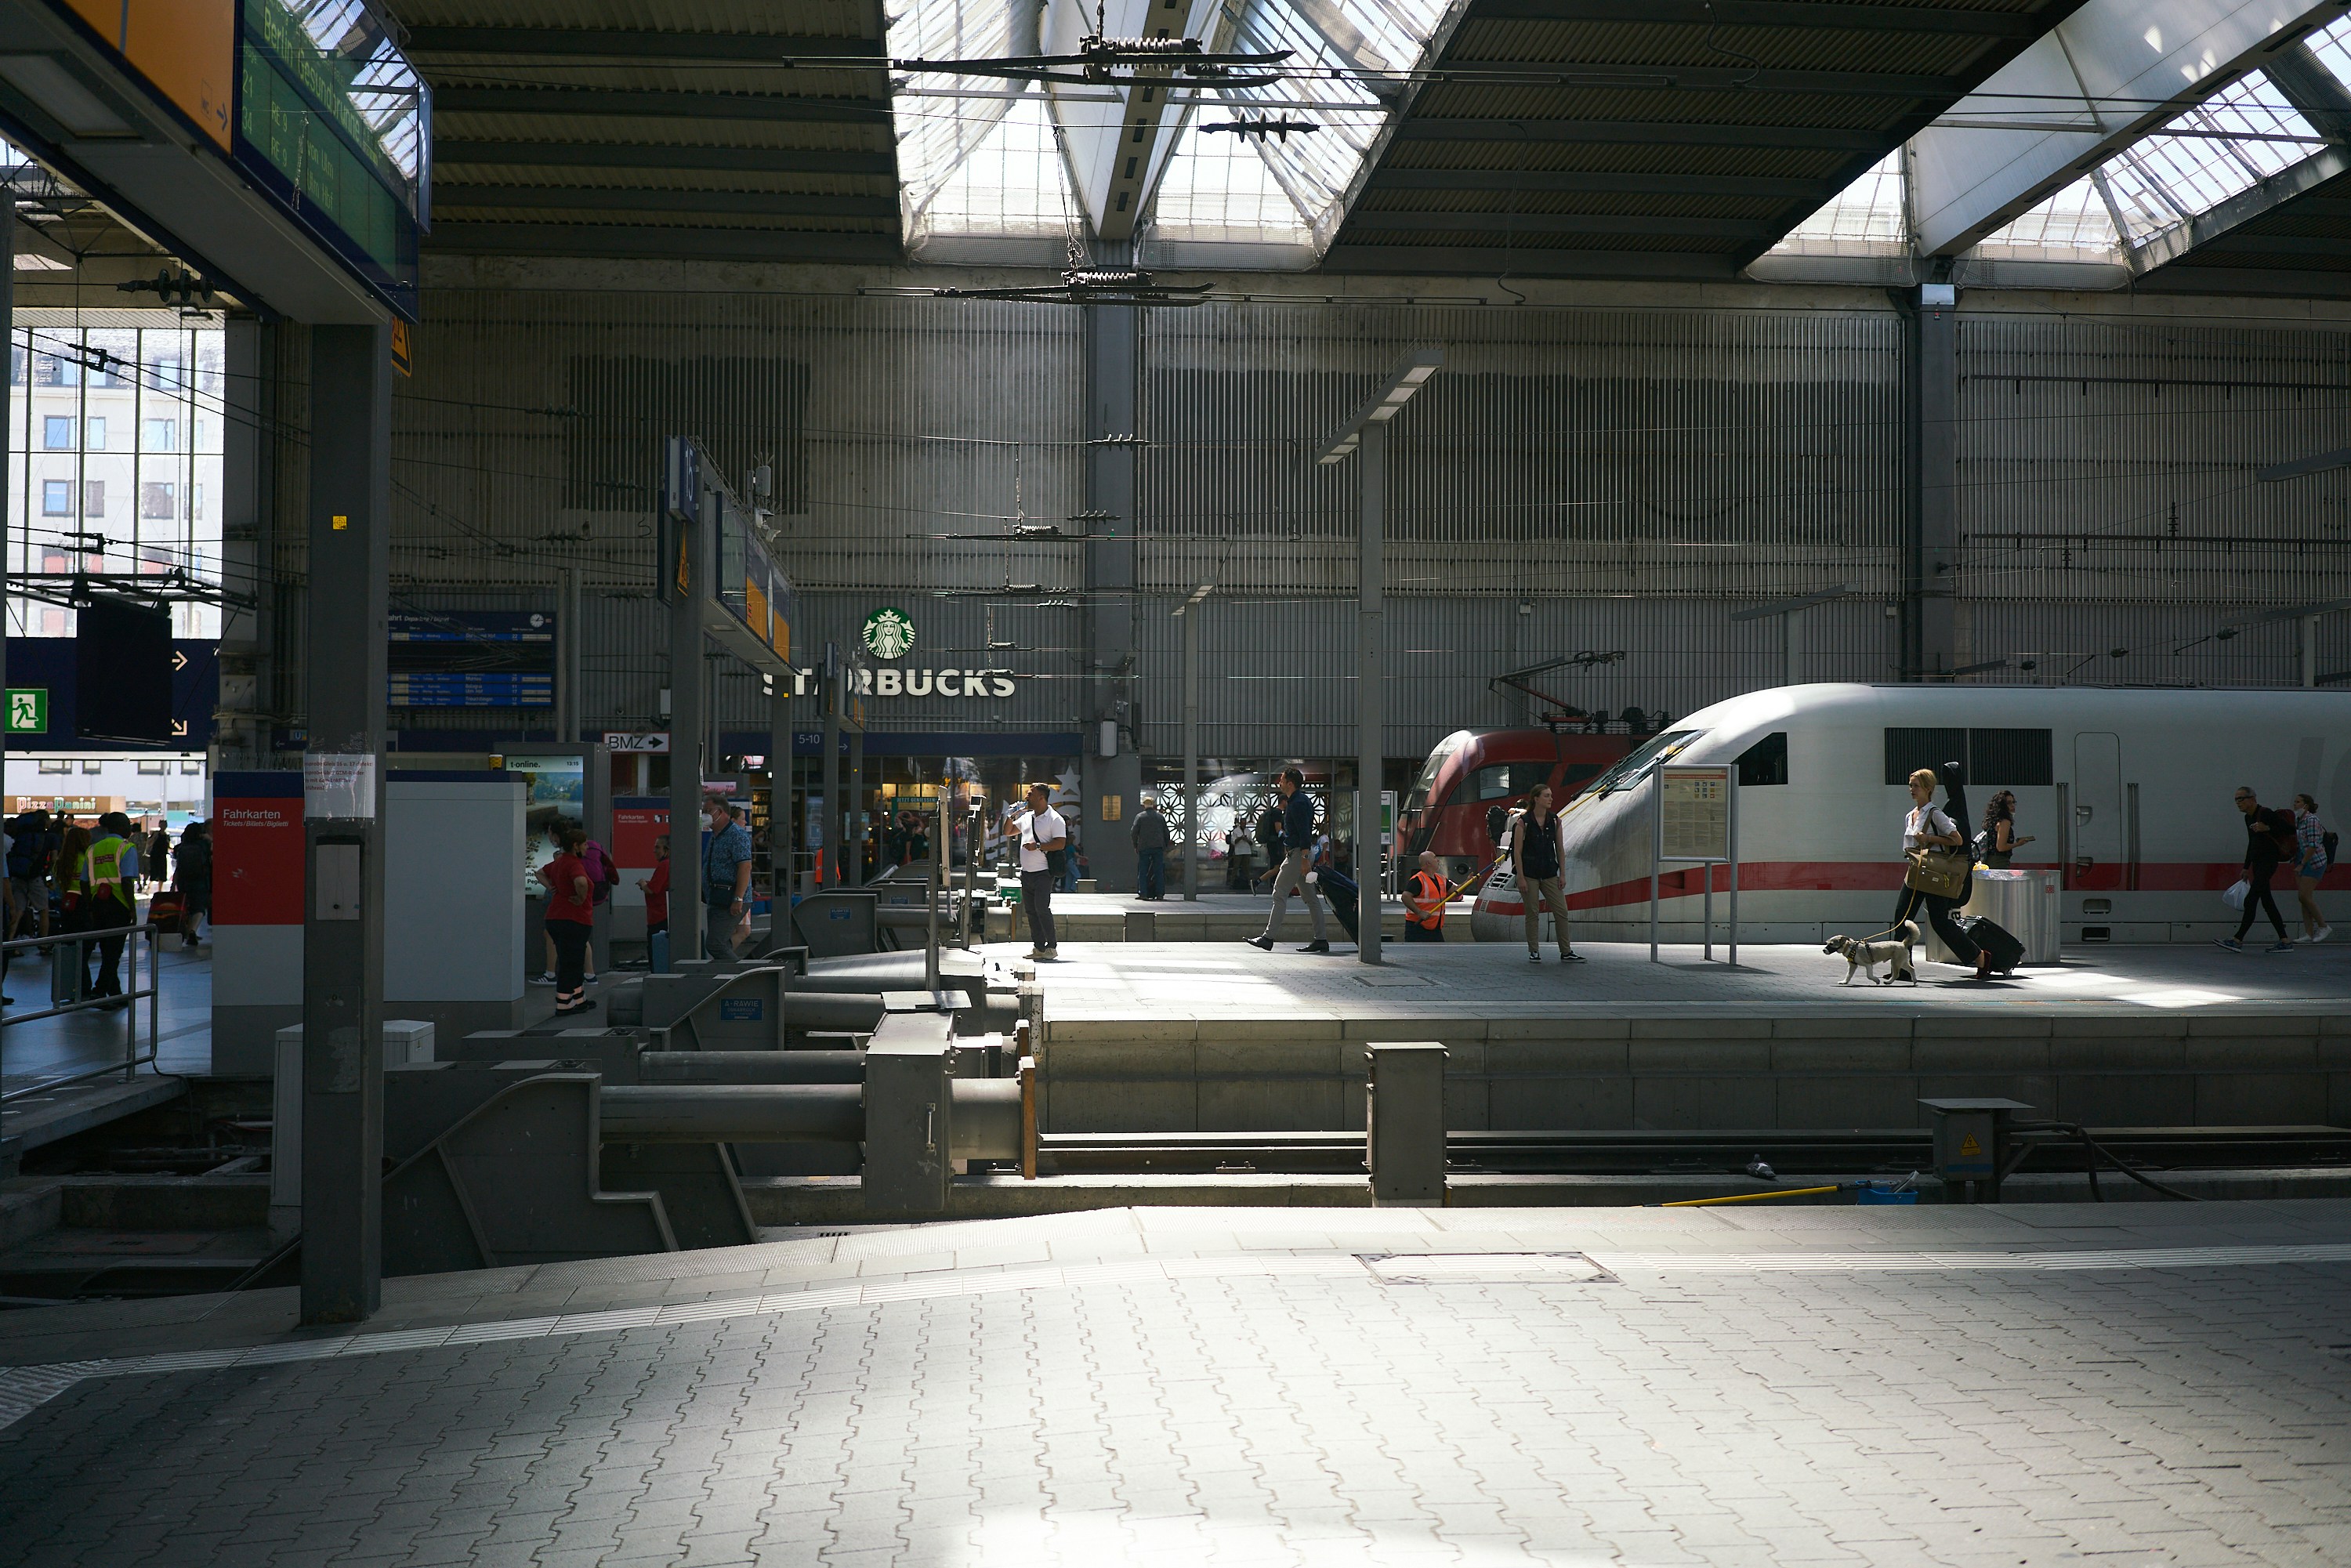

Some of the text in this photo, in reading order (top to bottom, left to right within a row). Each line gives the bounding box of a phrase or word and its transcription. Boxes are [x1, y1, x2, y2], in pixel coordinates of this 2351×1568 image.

[264, 6, 293, 68] Berlin
[242, 68, 252, 98] 21
[242, 106, 252, 135] 34
[271, 101, 288, 132] RE 9
[271, 136, 280, 161] RE
[282, 148, 288, 167] 9
[685, 445, 694, 502] 15
[609, 736, 644, 749] BMZ
[799, 734, 820, 744] 5-10
[223, 809, 281, 820] Fahrkarten
